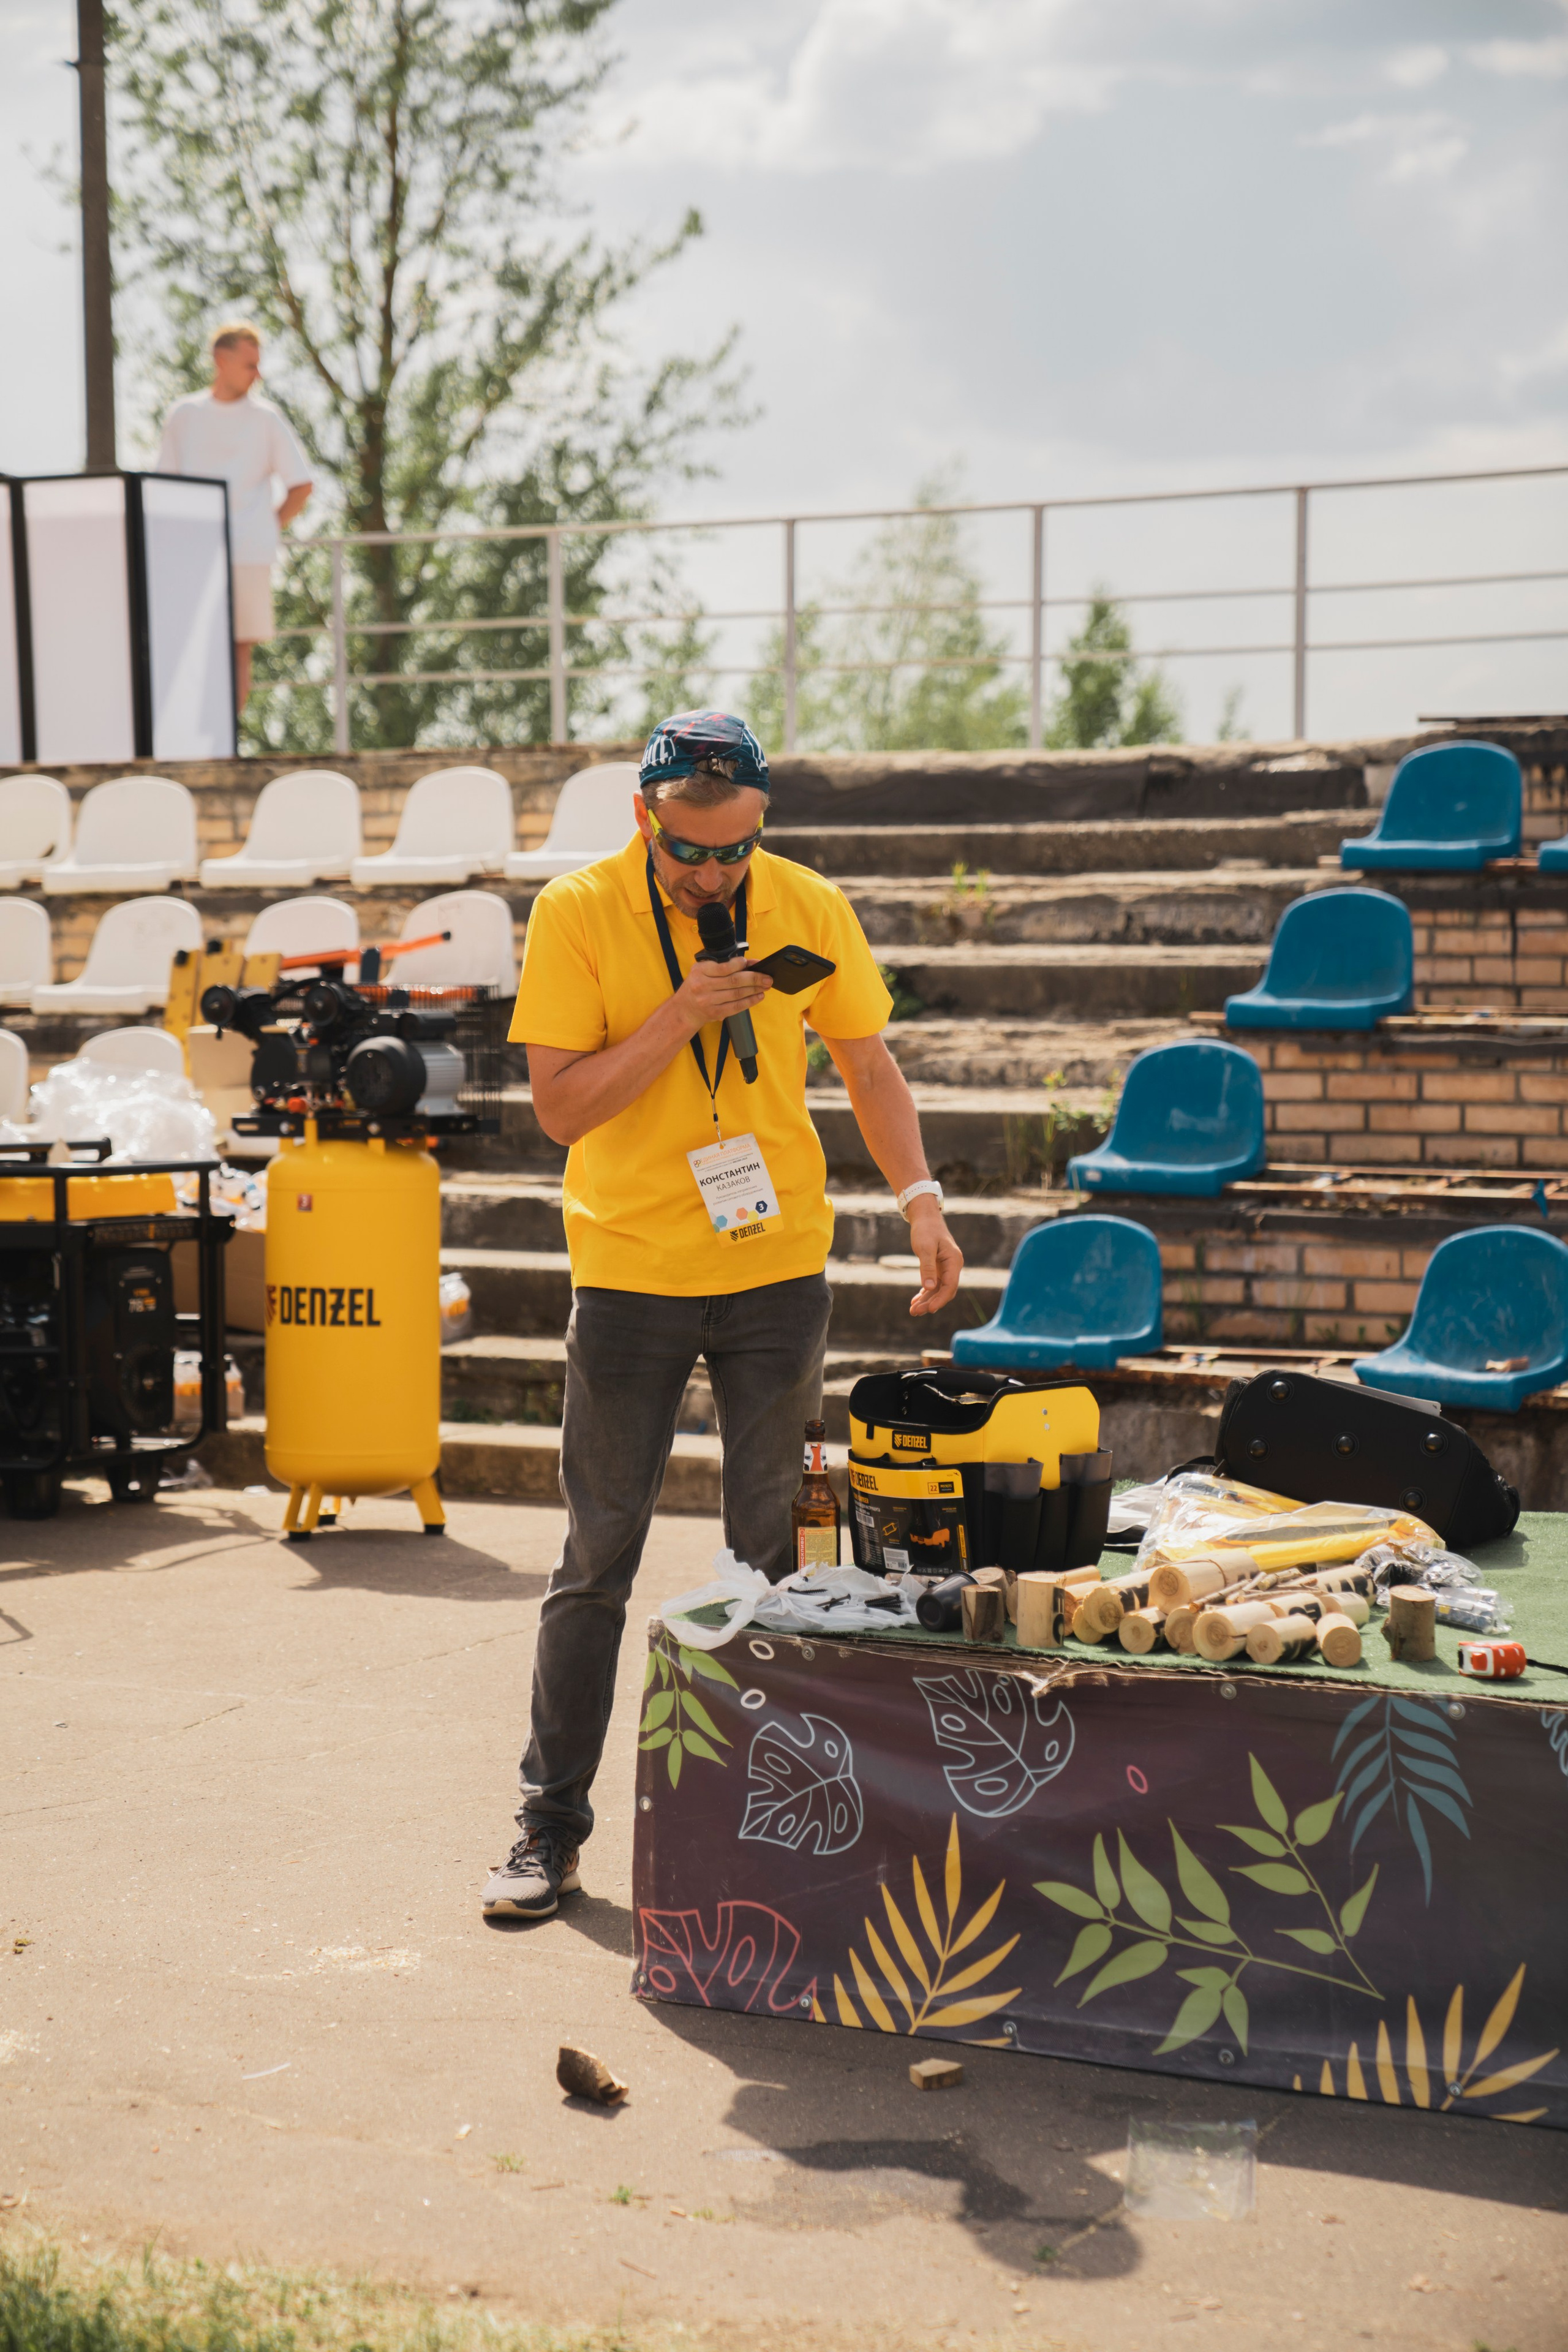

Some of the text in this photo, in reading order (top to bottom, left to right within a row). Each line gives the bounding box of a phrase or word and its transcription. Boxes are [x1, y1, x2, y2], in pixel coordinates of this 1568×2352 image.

[699, 1162, 761, 1187] КОНСТАНТИН
[716, 1175, 751, 1192] КАЗАКОВ
[738, 1222, 766, 1239] DENZEL
[280, 1286, 381, 1327] DENZEL
[902, 1434, 928, 1449] DENZEL
[854, 1471, 879, 1491] DENZEL
